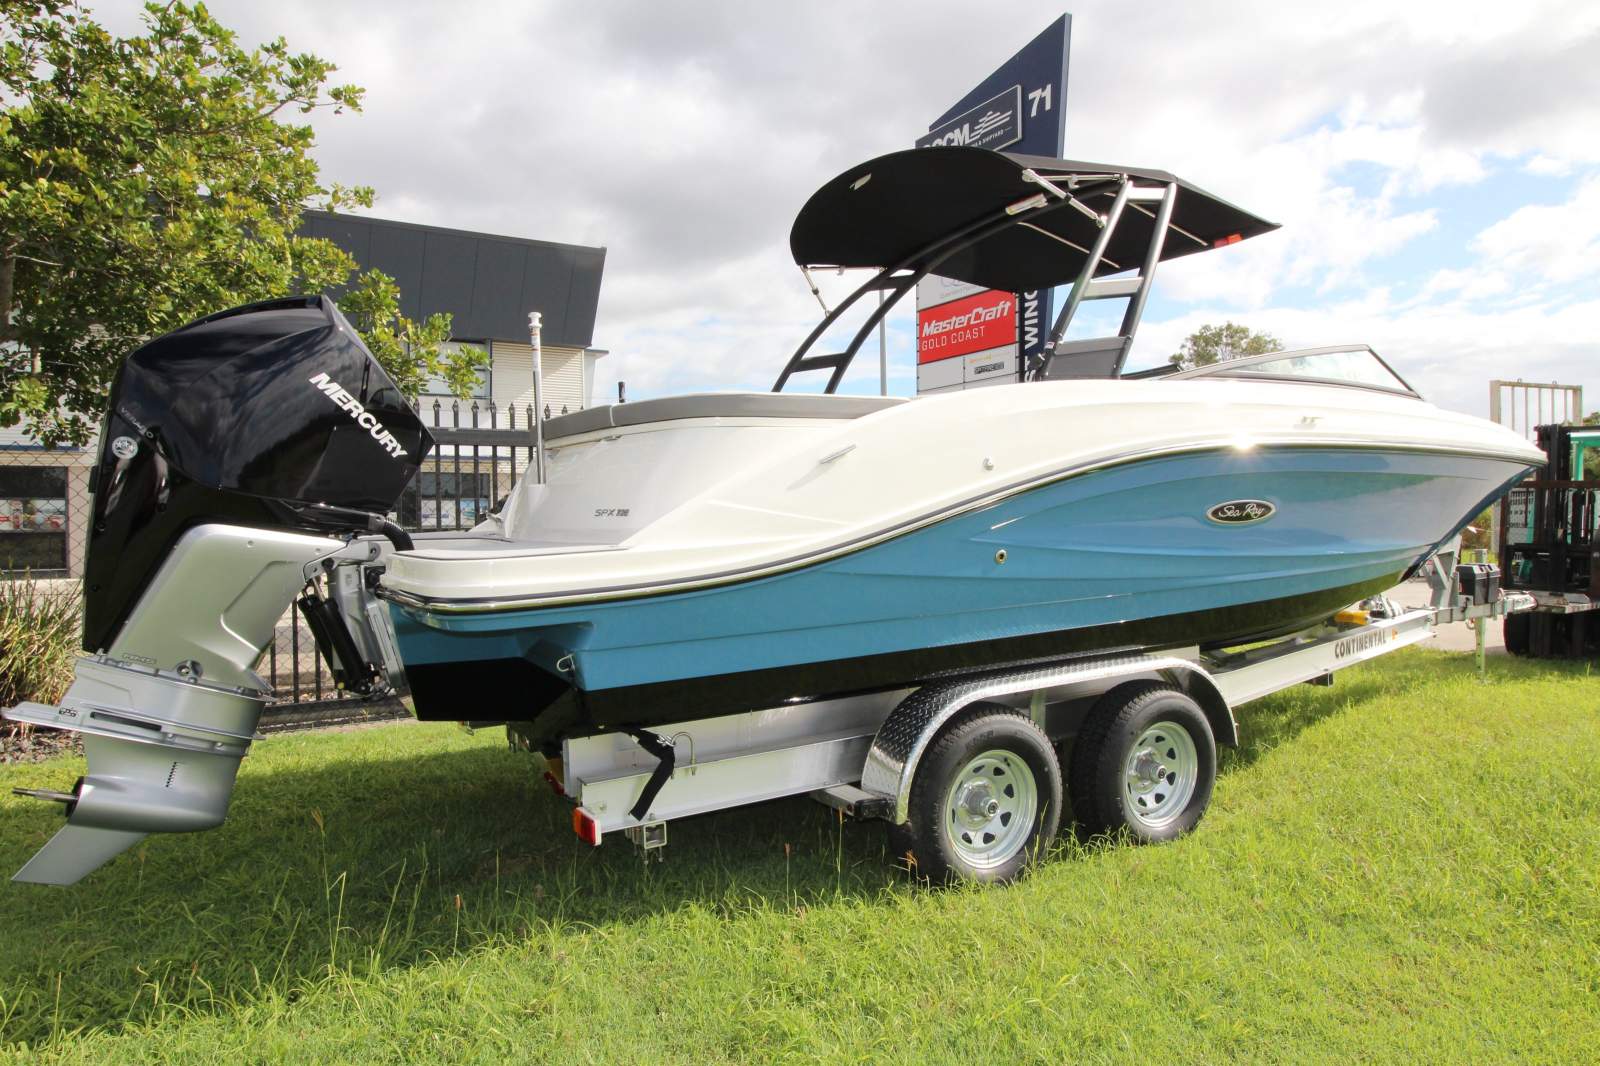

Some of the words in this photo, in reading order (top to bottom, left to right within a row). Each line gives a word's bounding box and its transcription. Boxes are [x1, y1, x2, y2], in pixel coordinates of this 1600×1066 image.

[1028, 83, 1052, 118] 71
[923, 122, 970, 147] CM
[921, 300, 1012, 338] MasterCraft
[921, 335, 947, 352] GOLD
[951, 326, 986, 344] COAST
[308, 372, 410, 458] MERCURY
[594, 508, 616, 517] SPX
[1218, 505, 1242, 518] Sea
[1243, 503, 1265, 519] Ray
[1334, 628, 1387, 660] CONTINENTAL
